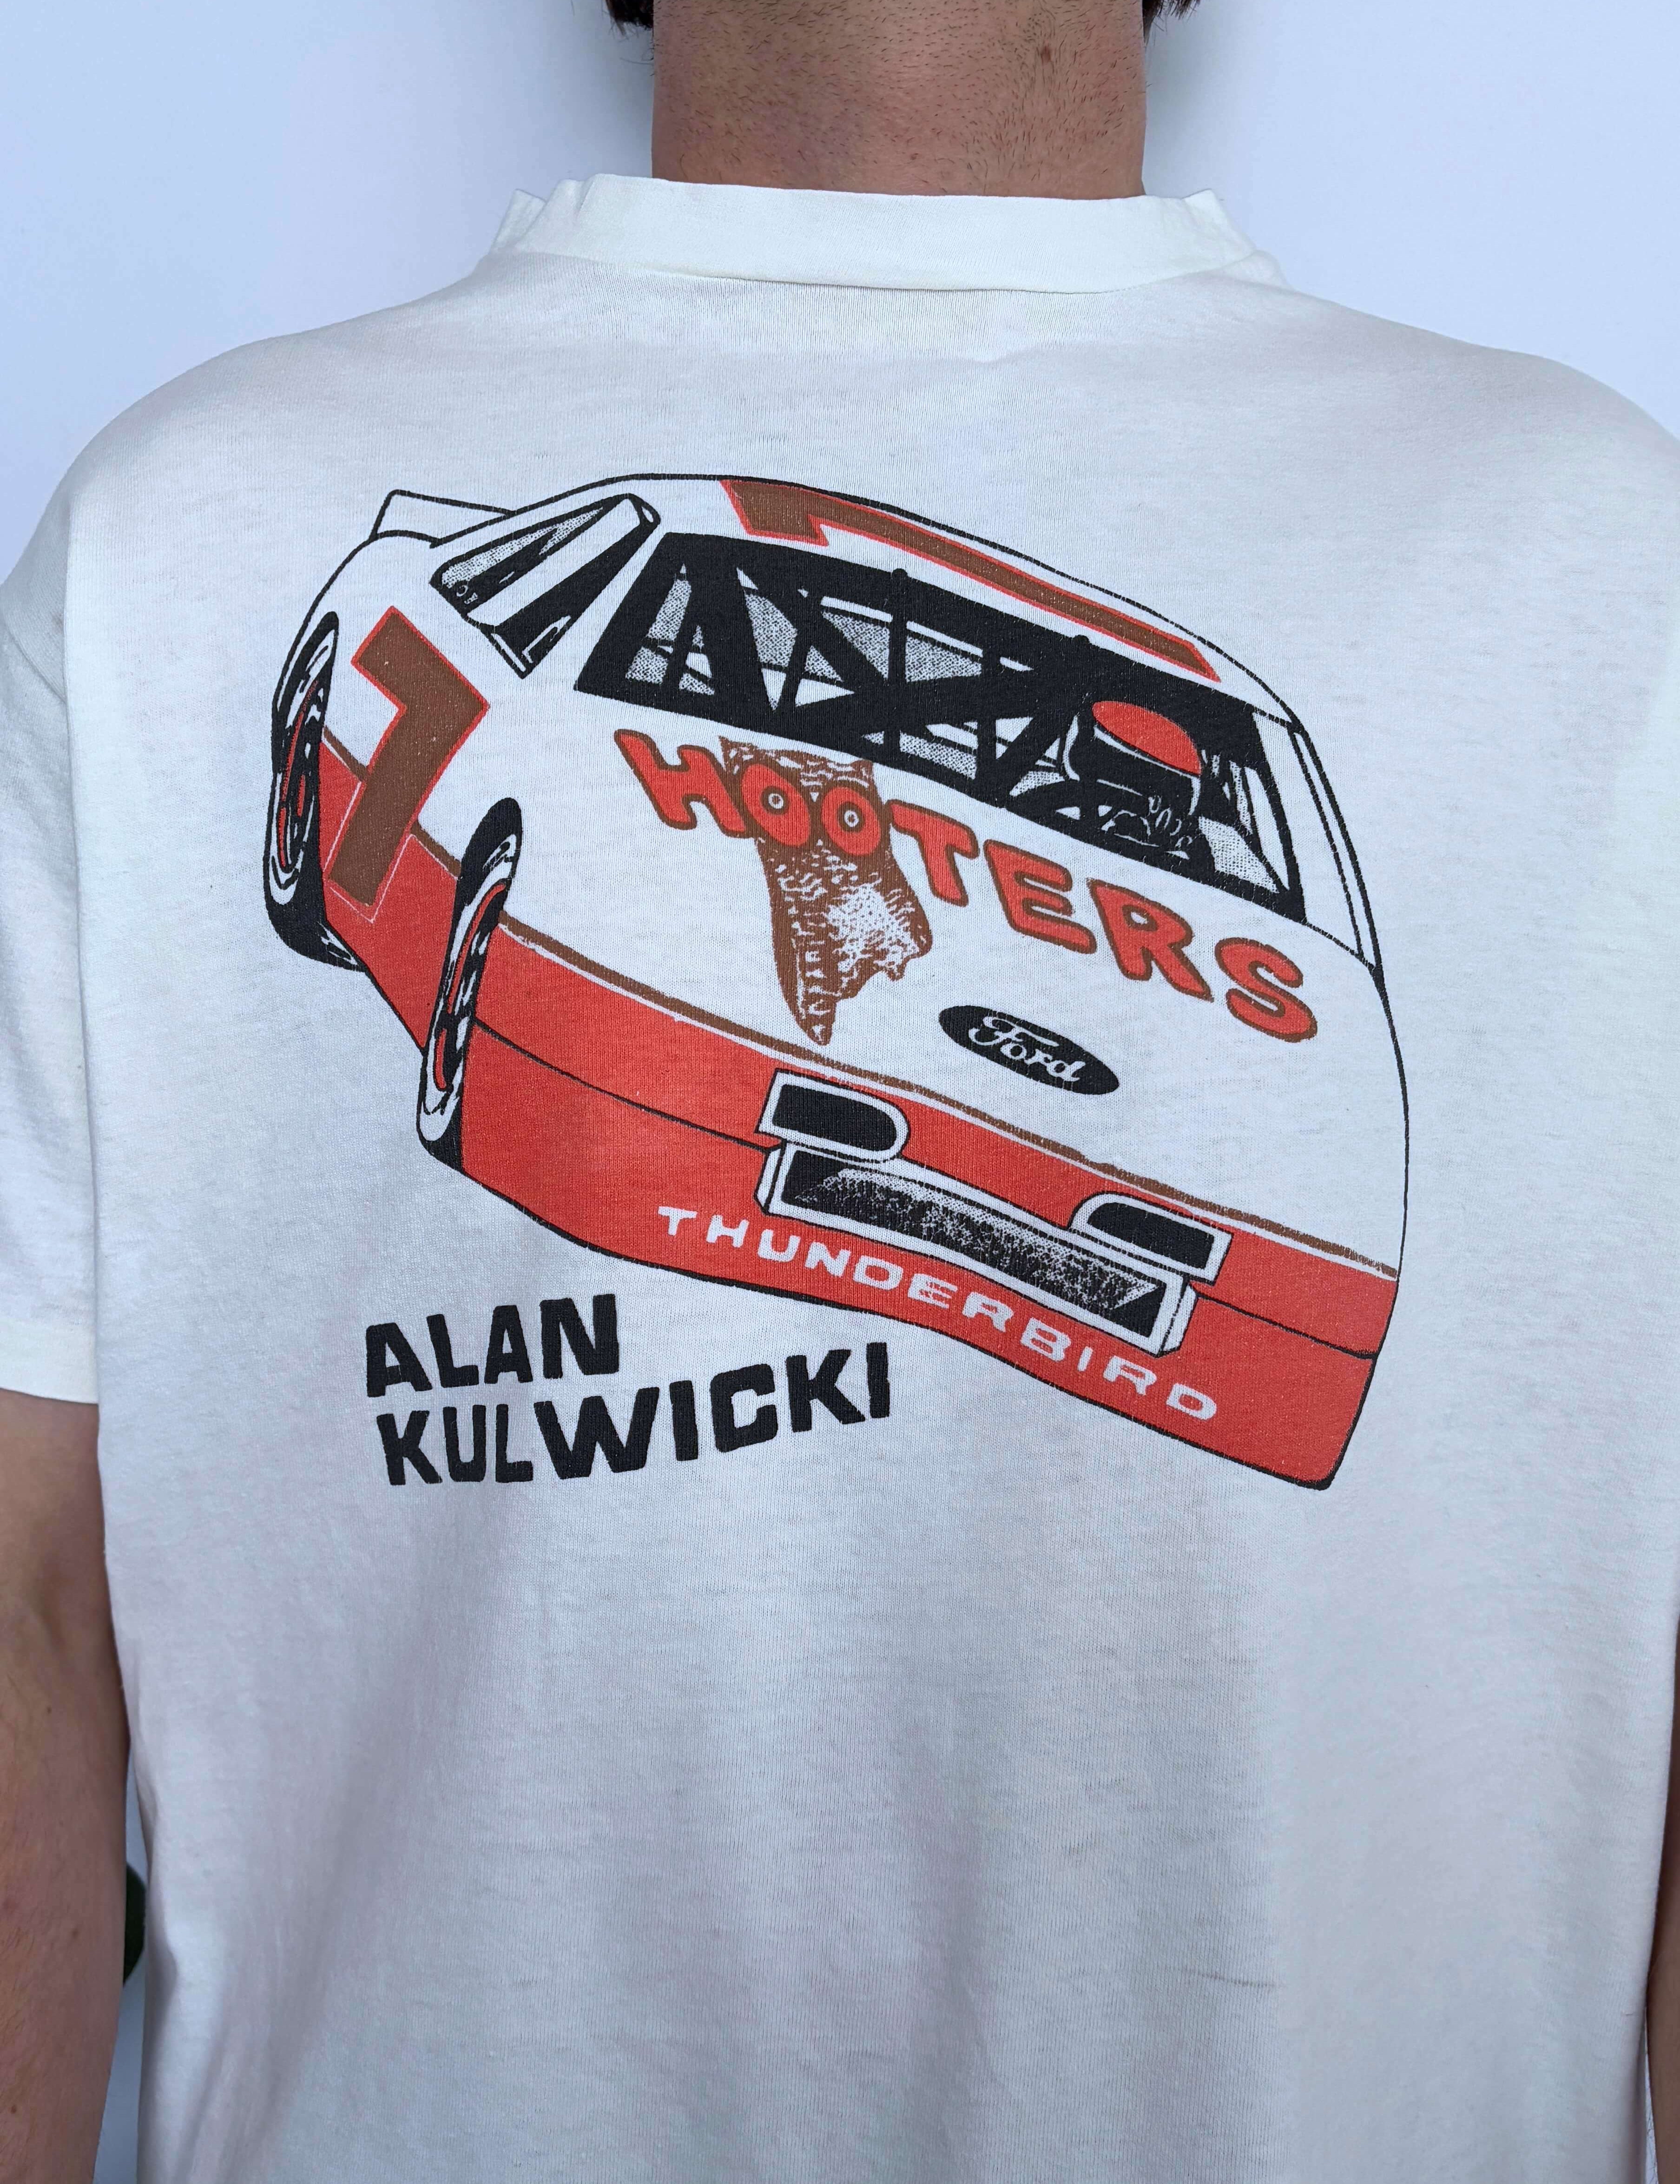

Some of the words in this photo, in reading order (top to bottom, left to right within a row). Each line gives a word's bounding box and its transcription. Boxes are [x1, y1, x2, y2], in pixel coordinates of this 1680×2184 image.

[324, 606, 490, 923] 7
[614, 728, 1318, 1043] HOOTERS
[967, 1015, 1086, 1083] Ford
[365, 1293, 620, 1398] ALAN
[657, 1205, 1218, 1421] THUNDERBIRD
[376, 1342, 891, 1486] KULWICKI
